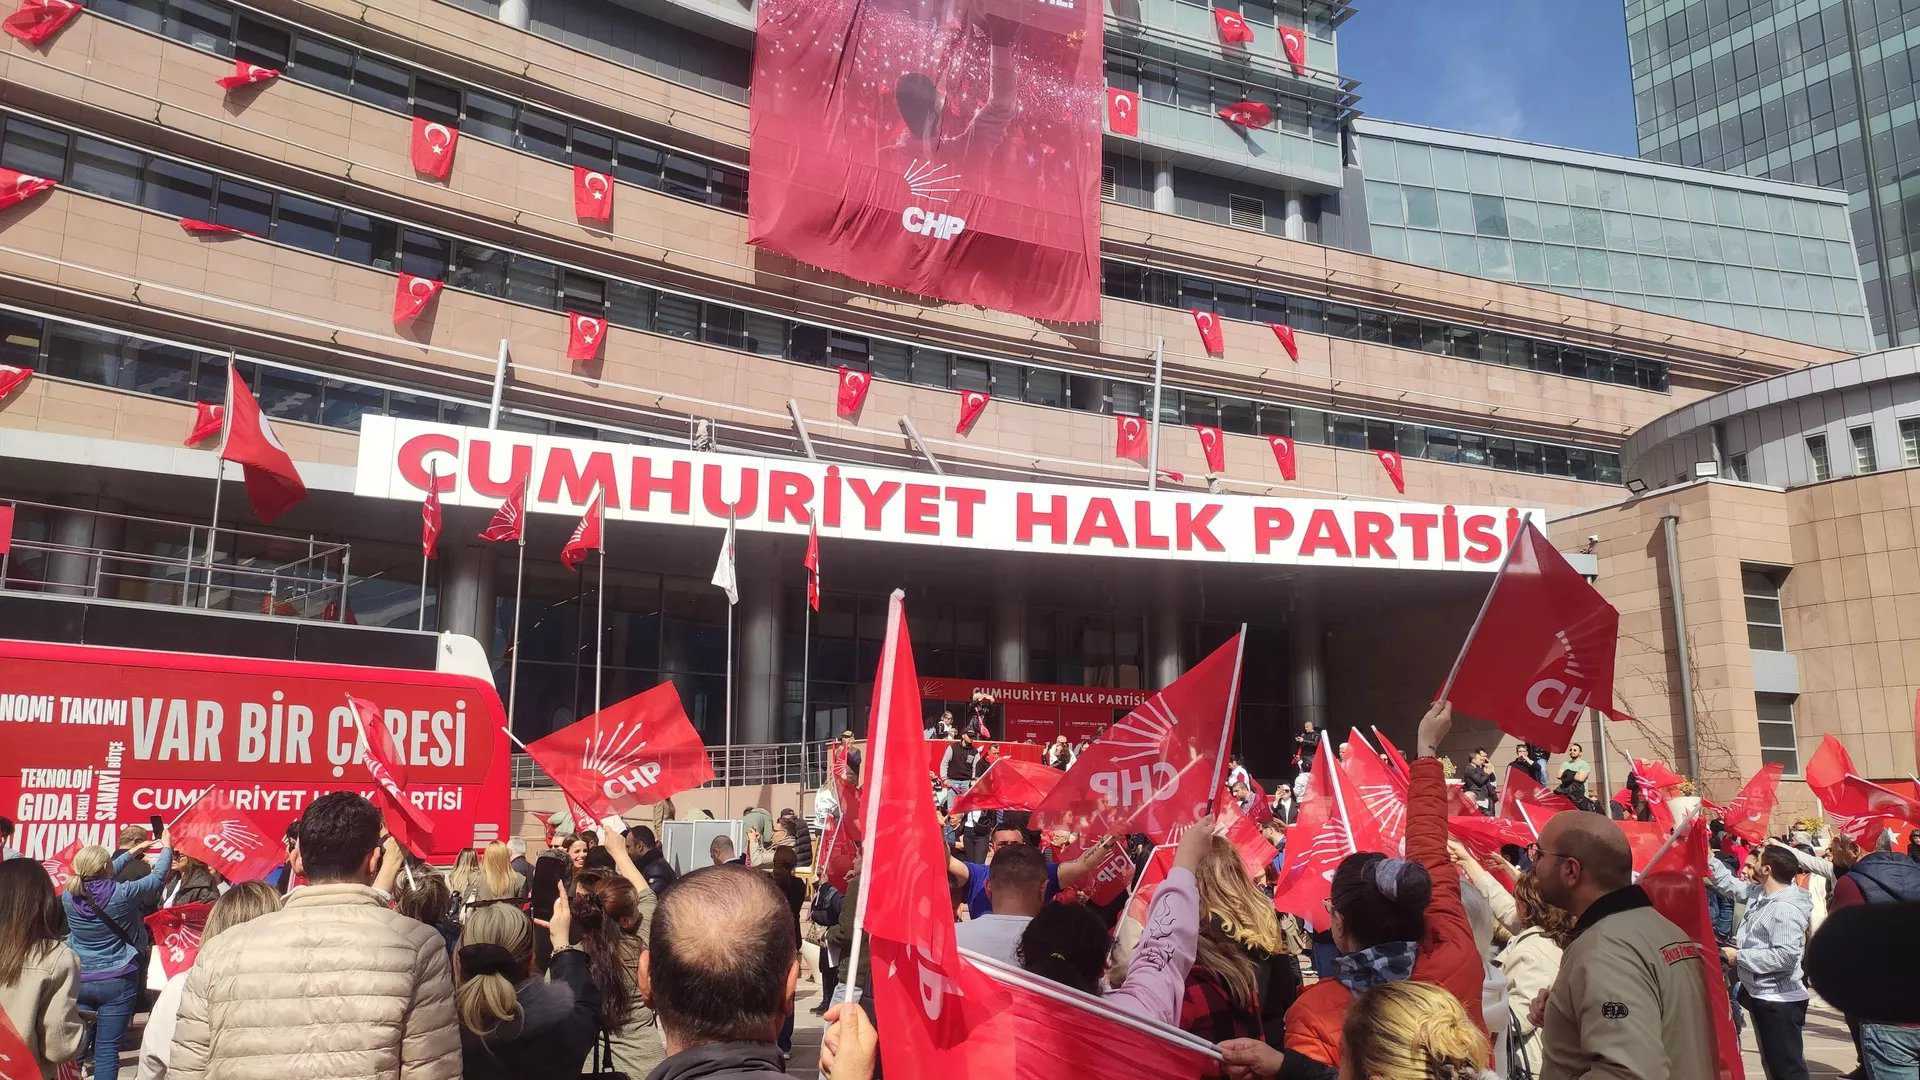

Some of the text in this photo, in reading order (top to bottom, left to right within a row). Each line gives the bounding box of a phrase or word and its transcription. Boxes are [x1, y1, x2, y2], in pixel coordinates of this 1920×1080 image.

[902, 206, 965, 240] CHP
[397, 433, 1525, 564] CUMHURİYET HALK PARTİSİ
[60, 696, 128, 726] TAKIMI
[1061, 692, 1094, 704] HALK
[1525, 678, 1592, 727] CH
[132, 697, 225, 763] VAR
[239, 690, 314, 767] BİR
[94, 769, 121, 821] SANAYİ
[602, 761, 662, 800] CHP
[17, 793, 74, 821] GIDA
[402, 787, 463, 811] RTİSİ
[202, 832, 246, 864] CHP
